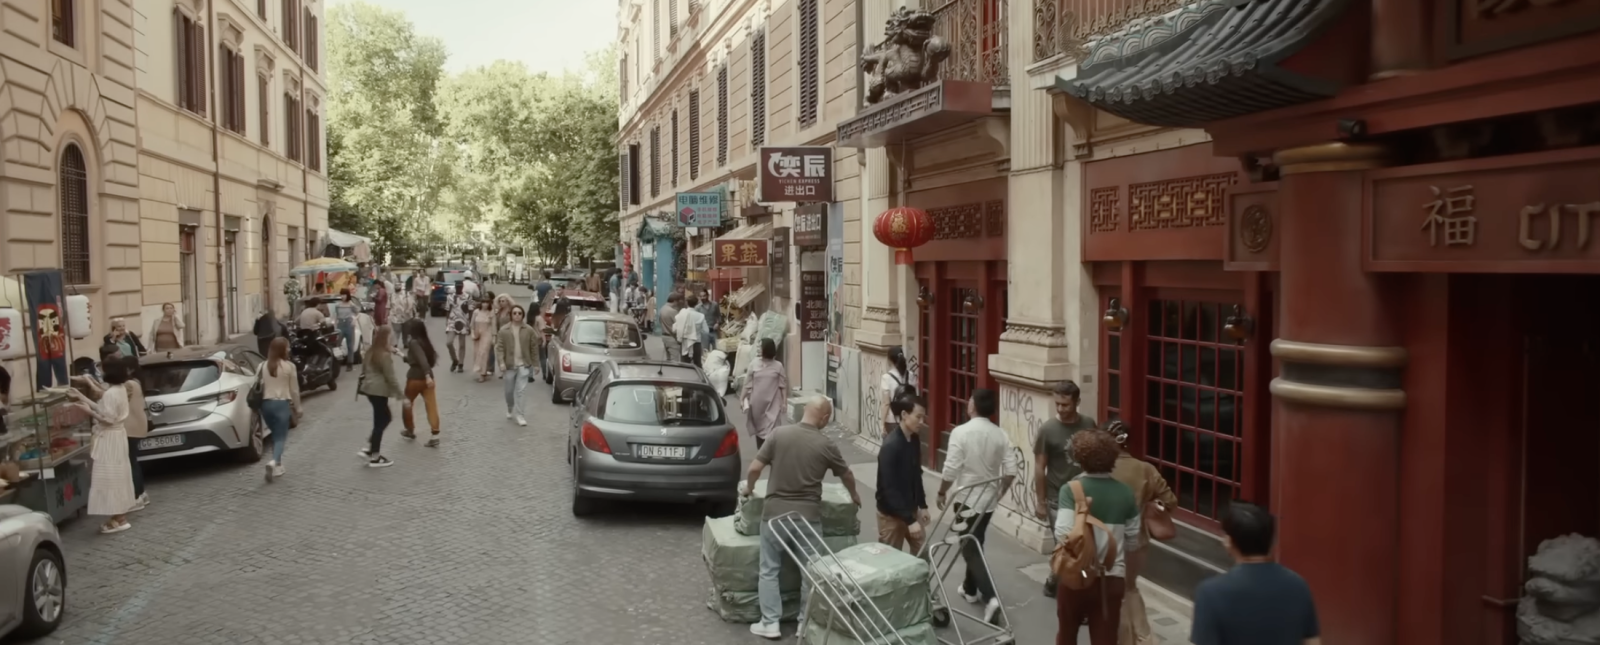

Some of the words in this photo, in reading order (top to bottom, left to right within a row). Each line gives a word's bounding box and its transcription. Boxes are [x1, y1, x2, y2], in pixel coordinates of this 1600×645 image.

[768, 152, 825, 177] 奕辰
[784, 185, 815, 195] 进出口
[679, 195, 718, 205] 电脑维修
[1421, 184, 1477, 247] 福
[721, 242, 763, 264] 果蔬
[643, 446, 654, 456] DN
[657, 446, 685, 457] 611FJ
